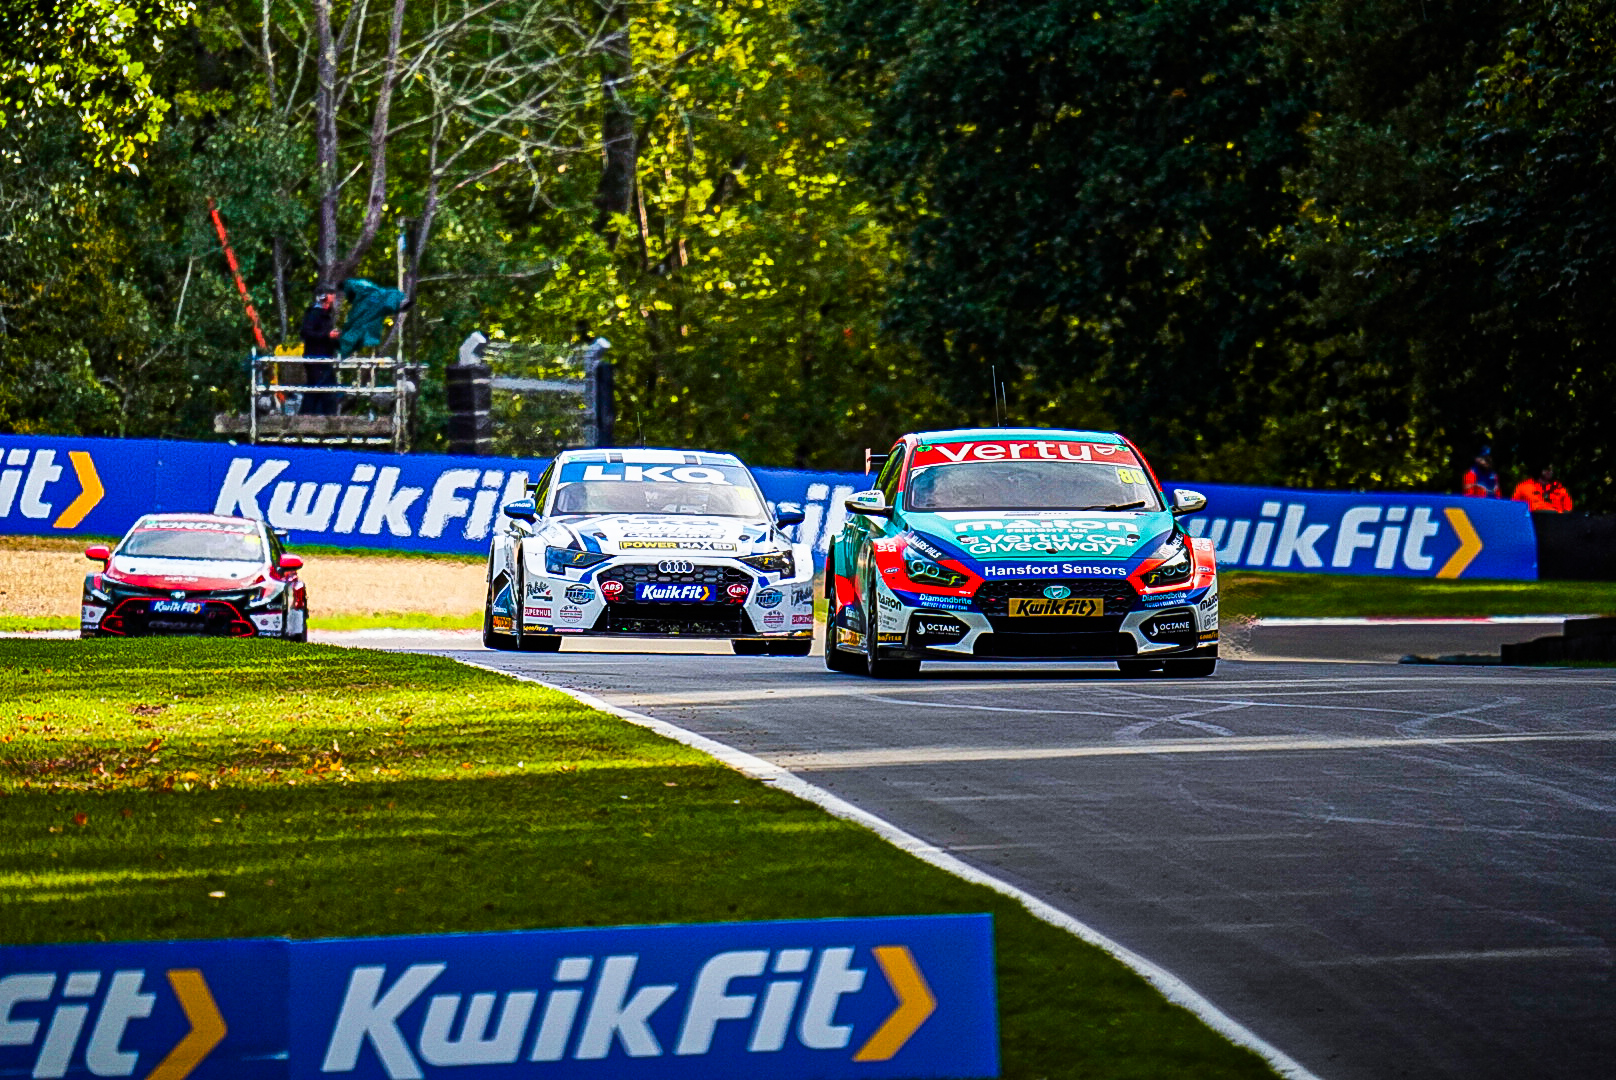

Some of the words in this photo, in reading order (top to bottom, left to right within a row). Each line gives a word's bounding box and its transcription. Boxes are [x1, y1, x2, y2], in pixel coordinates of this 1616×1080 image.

[583, 465, 734, 485] LKQ
[1117, 468, 1147, 485] 80
[622, 541, 678, 549] POWER
[984, 564, 1059, 577] Hansford
[1062, 563, 1127, 576] Sensors
[918, 593, 973, 605] Diamondbrite
[926, 623, 960, 633] OCTANE
[1159, 621, 1190, 631] OCTANE
